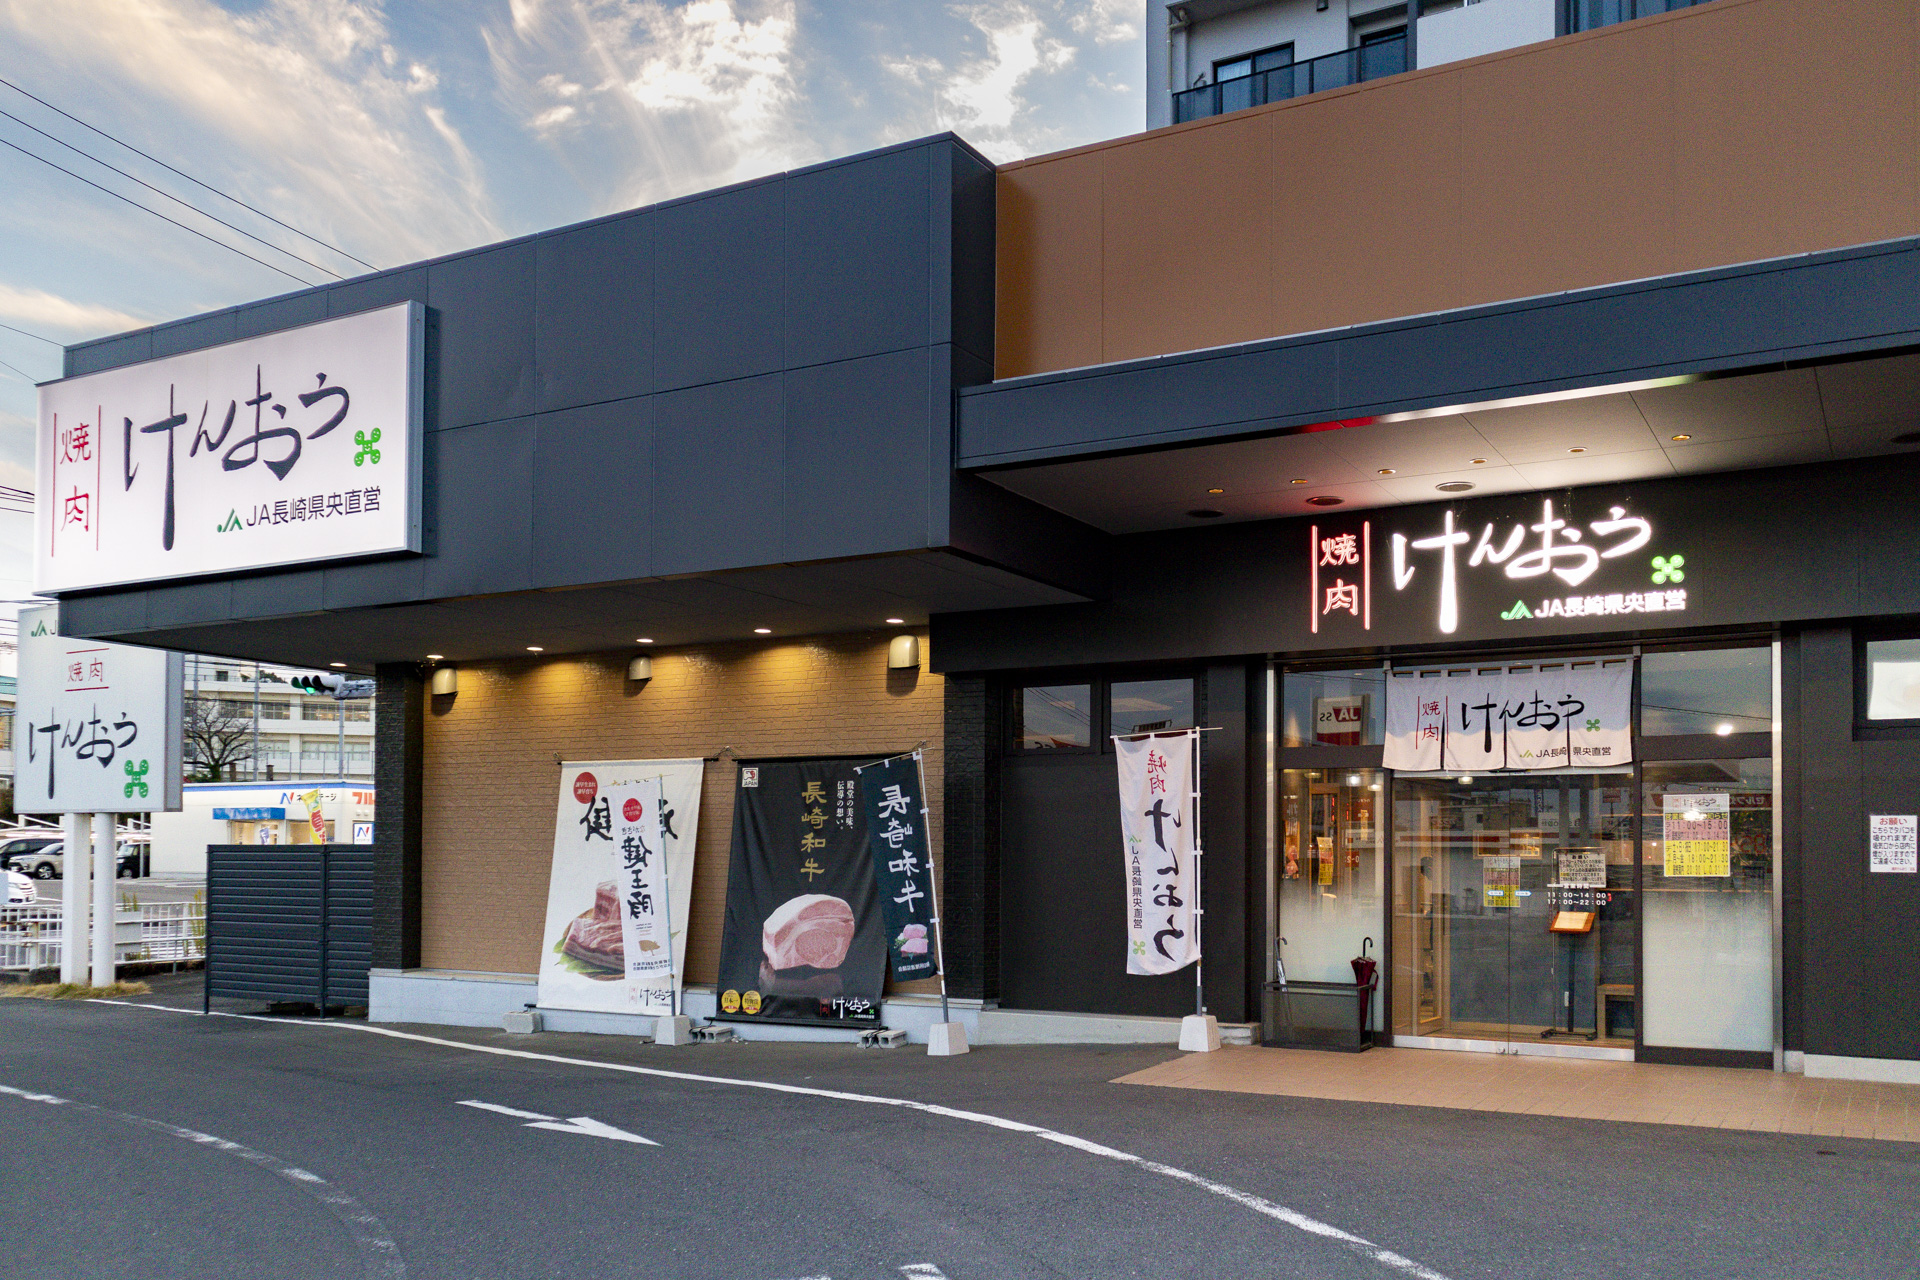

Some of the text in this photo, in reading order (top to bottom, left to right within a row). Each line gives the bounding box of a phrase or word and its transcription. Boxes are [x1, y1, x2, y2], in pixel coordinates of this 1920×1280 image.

[60, 422, 91, 532] 焼肉
[123, 364, 350, 551] けんおう
[246, 487, 381, 527] JA長崎県央直営
[1319, 533, 1360, 616] 焼肉
[1392, 499, 1652, 633] けんおう
[1535, 590, 1687, 619] JA長崎県央直営
[68, 657, 104, 683] 焼肉
[29, 703, 138, 799] けんおう
[1422, 700, 1441, 742] 焼肉
[1461, 690, 1585, 753] けんおう
[800, 781, 829, 882] 長崎和牛
[832, 996, 870, 1019] けんおう
